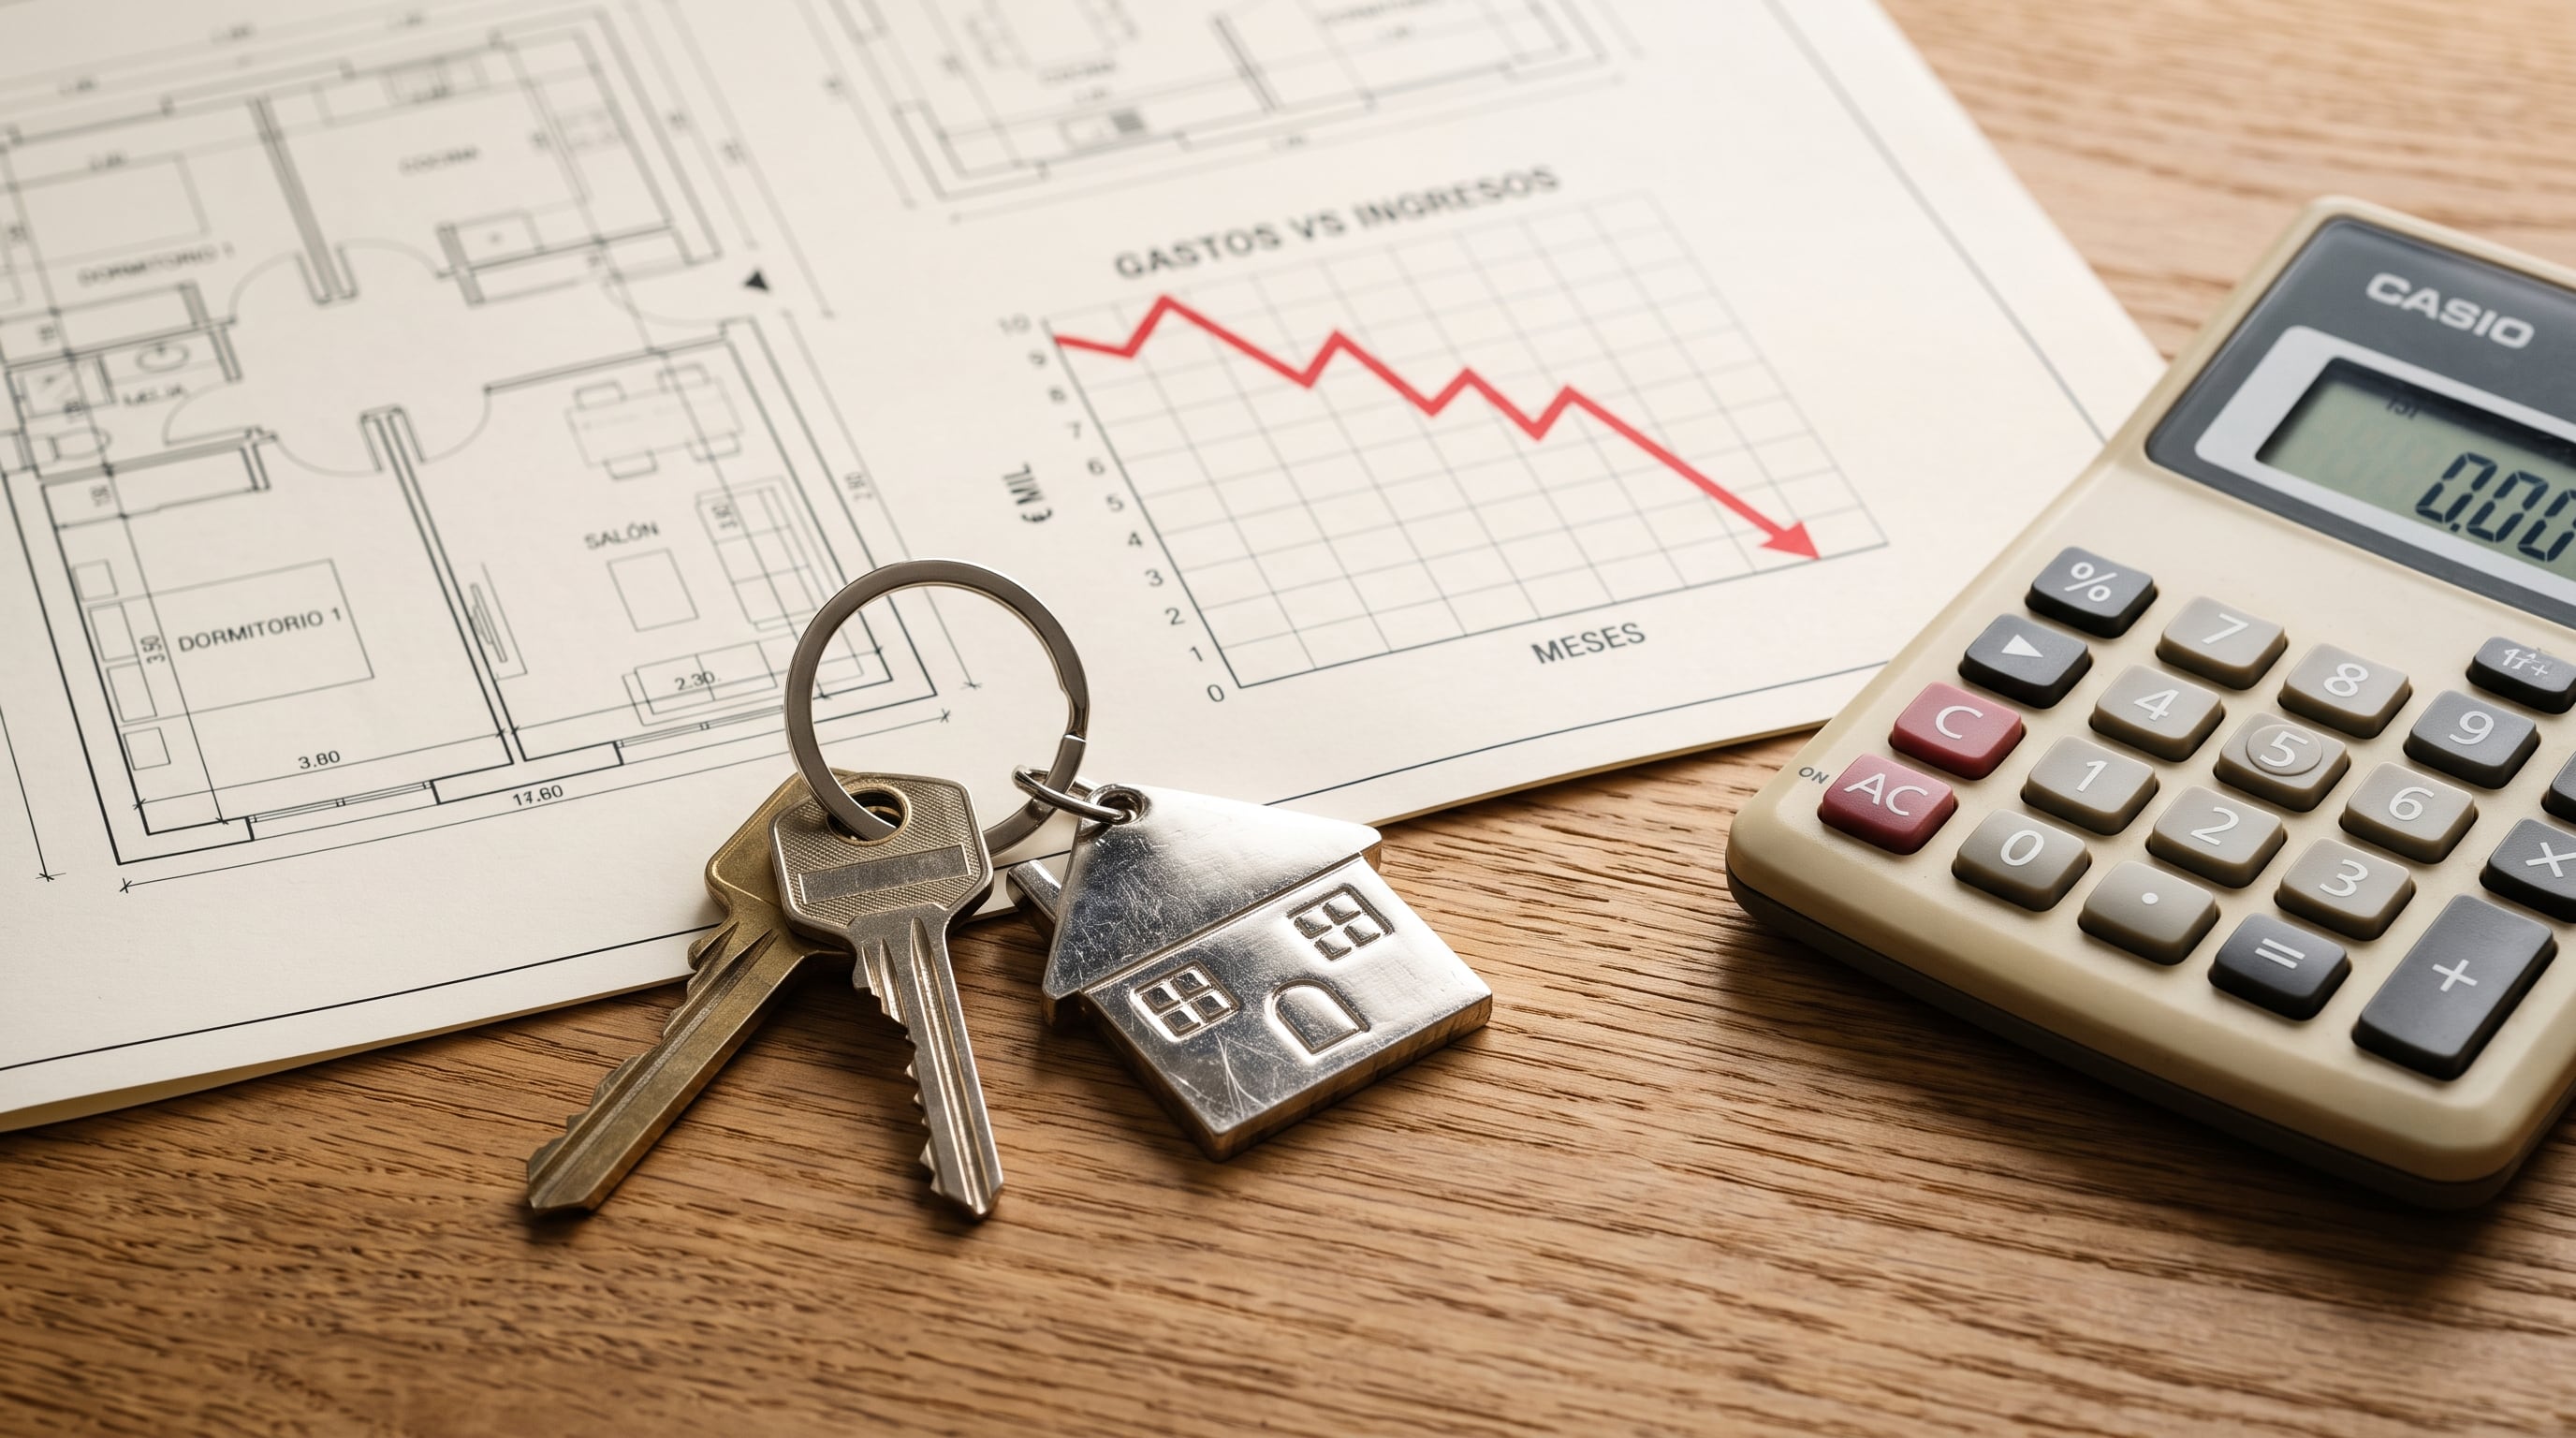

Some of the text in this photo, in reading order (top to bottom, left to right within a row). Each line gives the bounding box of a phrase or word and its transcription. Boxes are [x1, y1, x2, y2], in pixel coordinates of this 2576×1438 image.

[1115, 167, 1560, 279] GASTOS VS INGRESOS
[998, 314, 1031, 335] 10
[2366, 272, 2535, 349] CASIO
[1066, 421, 1082, 439] 7
[1087, 458, 1105, 476] 6
[1106, 494, 1124, 512] 5
[585, 521, 659, 550] SALÓN
[1127, 532, 1143, 549] 4
[1146, 569, 1164, 586] 3
[2064, 562, 2117, 602] %
[178, 607, 343, 653] DORMITORIO 1
[1165, 608, 1185, 625] 2
[2202, 612, 2248, 645] 7
[1189, 646, 1204, 662] 1
[1531, 623, 1646, 664] MESES
[1208, 684, 1224, 702] 0
[2323, 663, 2369, 697] 8
[2133, 688, 2179, 721] 4
[1935, 705, 1983, 740] C
[2449, 711, 2495, 745] 9
[2259, 730, 2308, 768] 5
[1798, 766, 1829, 785] ON
[2075, 760, 2108, 793] 1
[1843, 772, 1928, 816] AC
[2388, 786, 2435, 821] 6
[2190, 807, 2240, 846] 2
[2000, 829, 2044, 866] 0
[2319, 858, 2368, 897] 3
[2432, 959, 2478, 992] +
